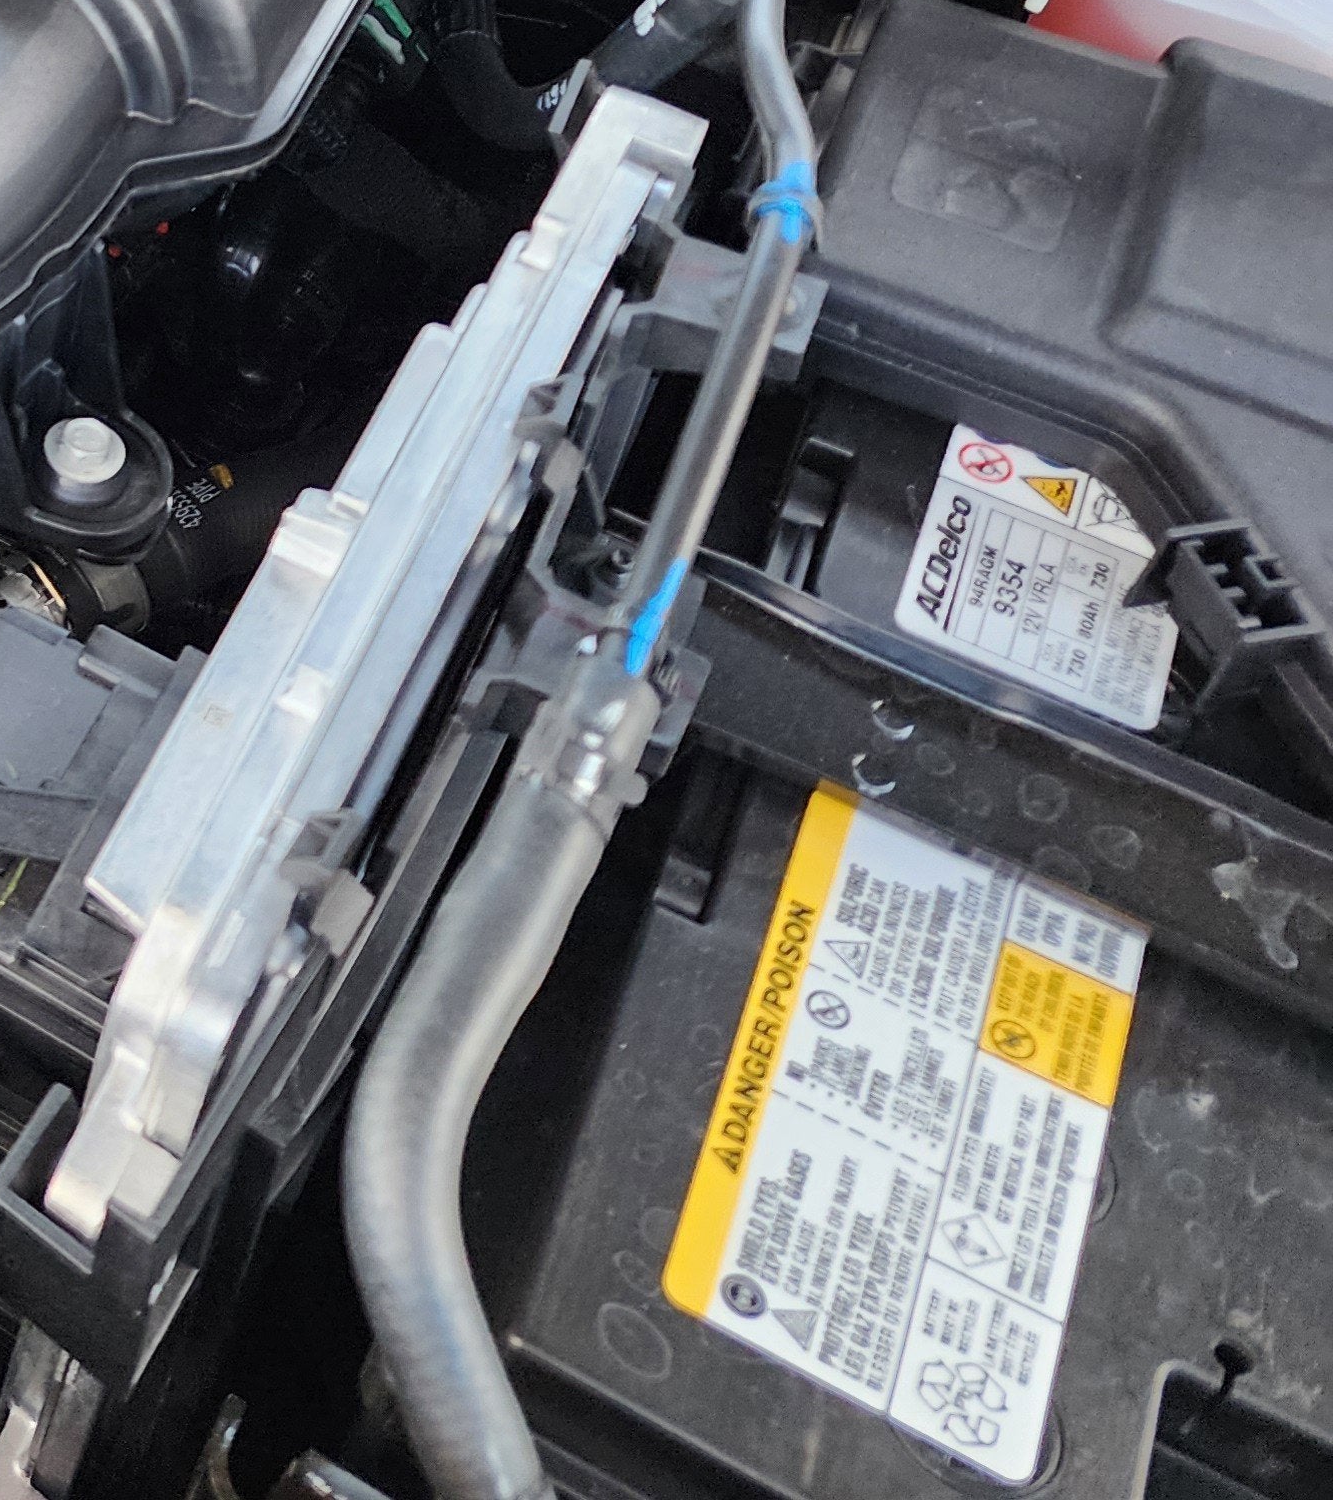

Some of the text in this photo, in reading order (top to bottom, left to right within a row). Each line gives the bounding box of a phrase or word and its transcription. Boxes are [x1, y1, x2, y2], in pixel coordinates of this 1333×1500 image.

[911, 490, 974, 623] ACDelco
[967, 543, 1001, 608] 94RAGM
[1089, 560, 1110, 591] 730
[990, 556, 1029, 618] 9354
[1020, 559, 1058, 638] 12V VRLA
[1077, 599, 1101, 640] 80Ah
[1066, 647, 1088, 679] 730
[834, 861, 870, 929] SULFURIC
[856, 876, 888, 936] ACID CAN
[919, 883, 957, 963] SULFURIQUE
[866, 879, 909, 988] CAUSE BLINDNESS
[893, 929, 919, 978] SEVERE
[954, 918, 972, 939] LA
[888, 975, 906, 998] OR
[941, 936, 970, 988] CAUSER
[717, 897, 816, 1156] DANGER/POISON
[933, 985, 956, 1021] PEUT
[960, 983, 981, 1012] DES
[824, 1042, 854, 1093] FLAMES
[843, 1044, 872, 1101] SMOKING
[858, 1065, 894, 1123] ÉVITER
[735, 1215, 769, 1275] SHIELD
[757, 1147, 813, 1286] EXPLOSIVE GASES
[782, 1217, 817, 1297] CAN CAUSE
[805, 1228, 840, 1309] BLINDNESS
[827, 1206, 845, 1230] OR
[839, 1254, 863, 1287] LES
[842, 1166, 913, 1382] LES GAZ EXPLOSIFS PEUVENT
